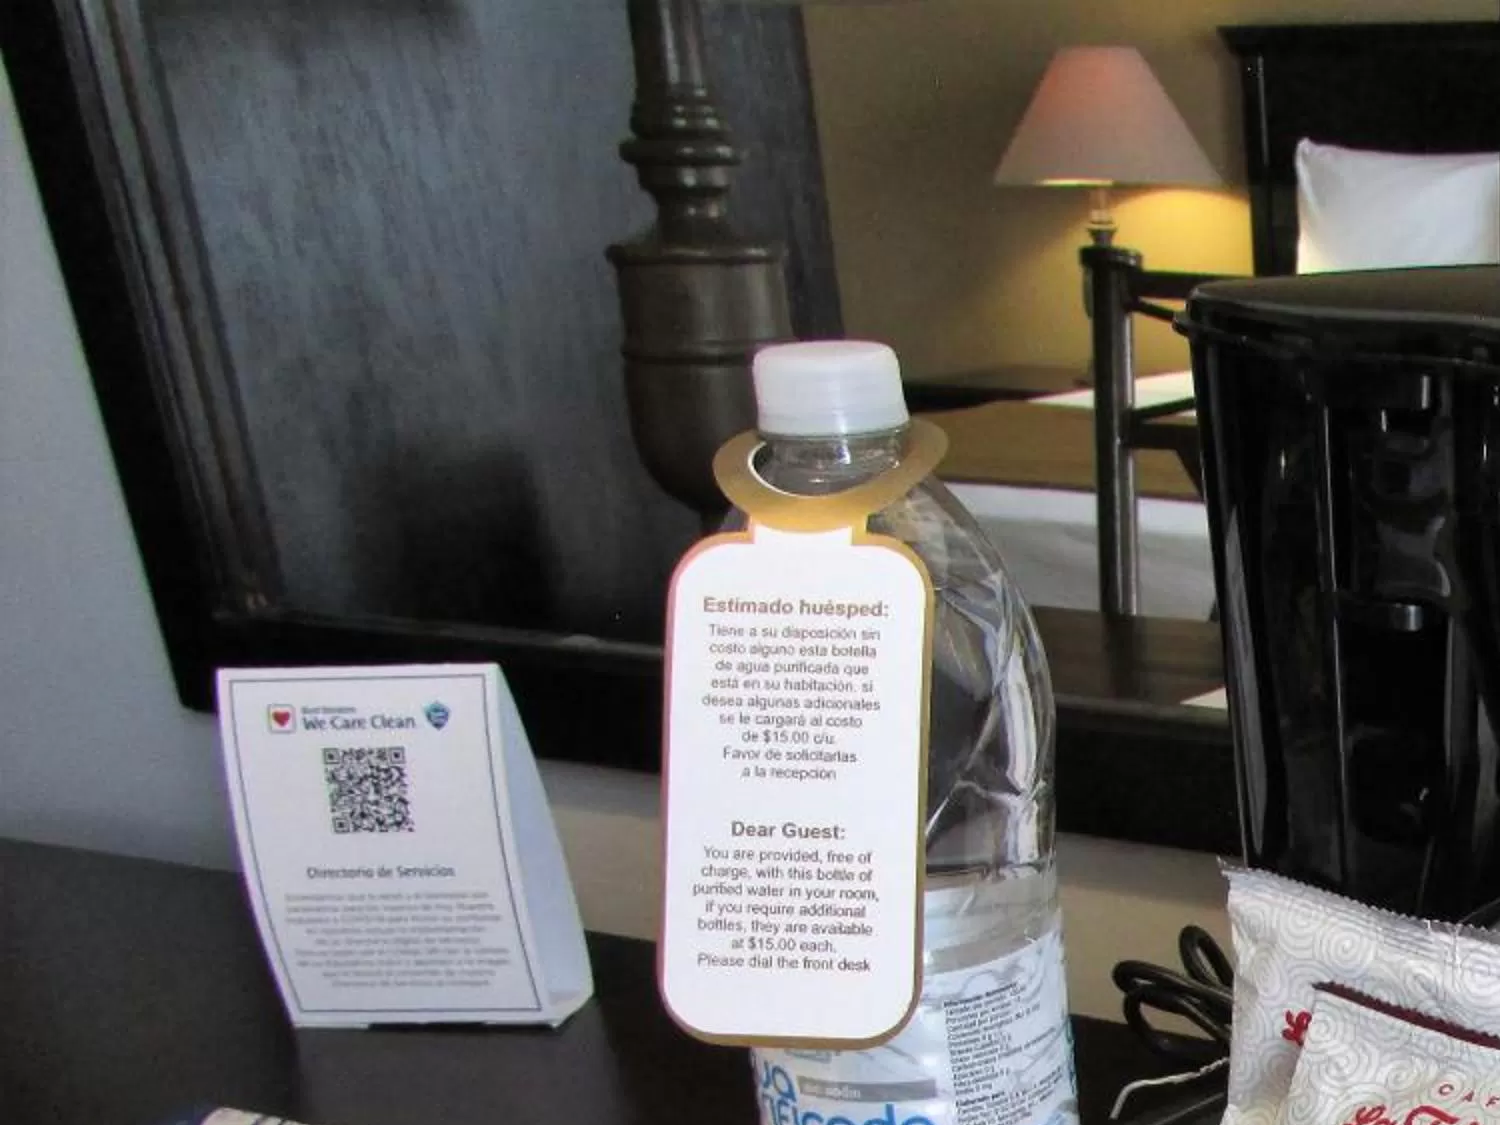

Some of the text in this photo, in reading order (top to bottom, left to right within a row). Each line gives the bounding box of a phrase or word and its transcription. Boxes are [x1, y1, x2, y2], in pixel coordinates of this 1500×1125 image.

[703, 597, 888, 620] Estimado huésped:
[709, 624, 880, 642] Tiene a su disposición sin
[709, 642, 877, 658] costo alguno esta botella
[716, 660, 869, 678] de agua purificada que
[711, 677, 738, 689] está
[743, 679, 760, 690] en
[764, 680, 780, 690] su
[702, 695, 880, 711] desea algunas adicionales
[303, 715, 416, 730] We Care Clean
[720, 712, 862, 728] se le cargará al costo
[742, 730, 759, 742] de
[764, 730, 809, 744] $15.00
[722, 746, 856, 762] Favor de solicitarlas
[742, 765, 836, 782] a la recepción
[731, 821, 846, 840] Dear Guest:
[704, 846, 872, 864] You are provided, free of
[701, 866, 872, 882] charge, with this bottle of
[692, 884, 880, 902] purified water in your room,
[718, 904, 742, 916] you
[747, 904, 794, 918] require
[799, 904, 866, 918] additional
[698, 918, 873, 936] bottles, they are available
[732, 937, 836, 954] at $15.00 each.
[697, 954, 870, 972] Please dial the front desk
